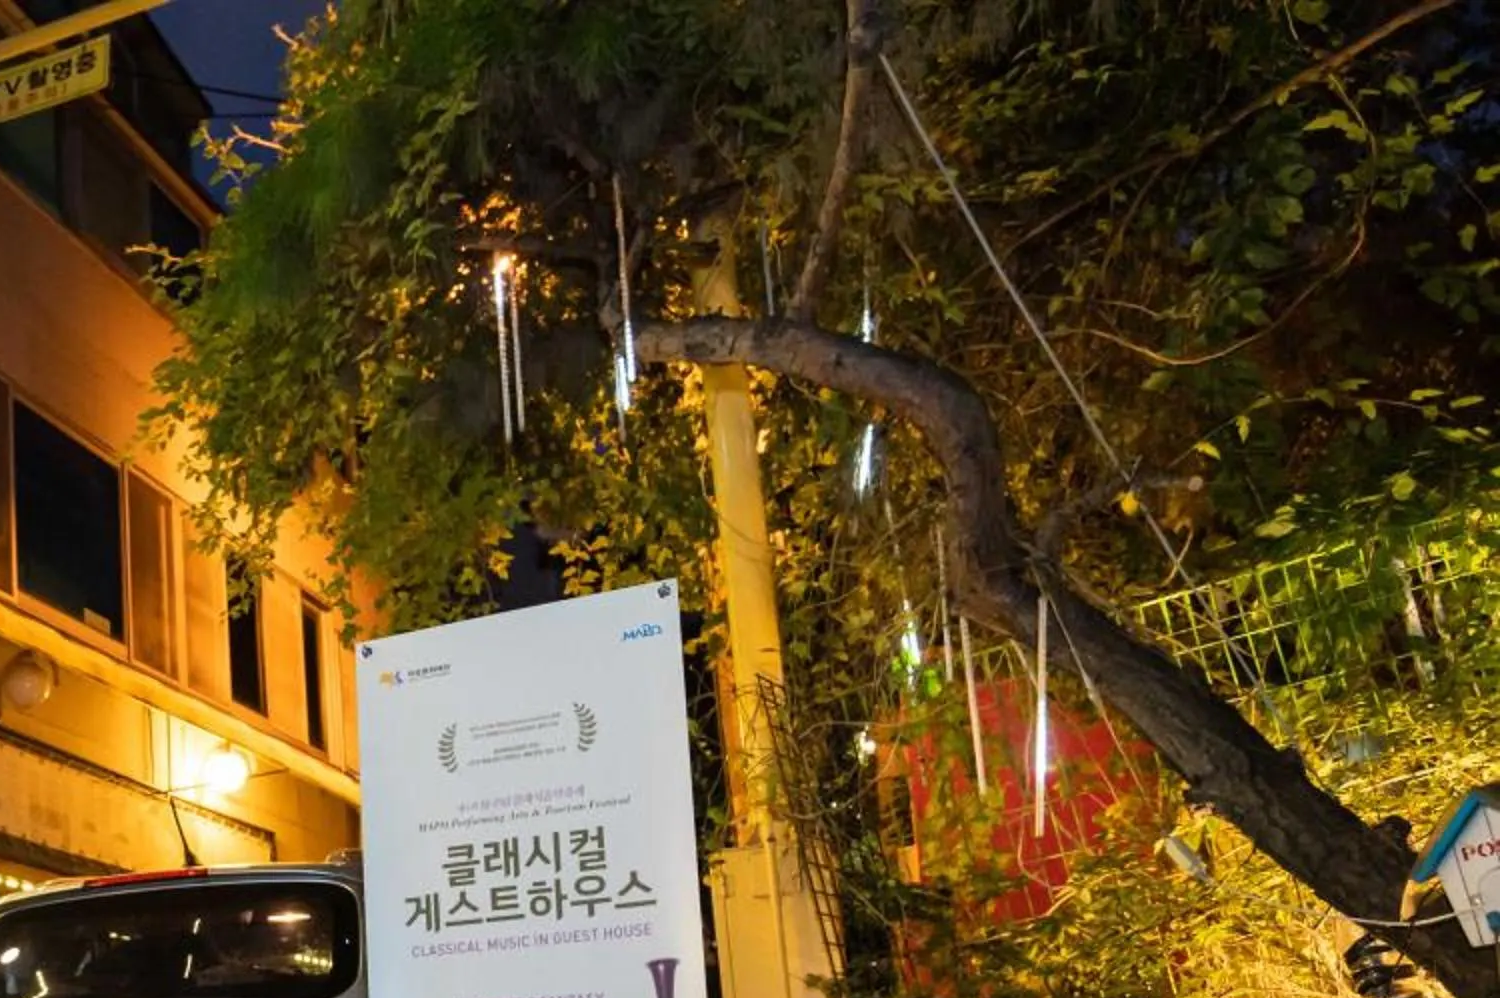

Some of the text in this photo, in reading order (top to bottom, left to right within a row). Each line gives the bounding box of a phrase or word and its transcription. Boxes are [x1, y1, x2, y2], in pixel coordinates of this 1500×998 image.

[442, 826, 607, 887] 클래시컬
[404, 870, 658, 933] 게스트하우스
[411, 923, 653, 958] CLASSICAL MUSIC IN GUEST HOUSE
